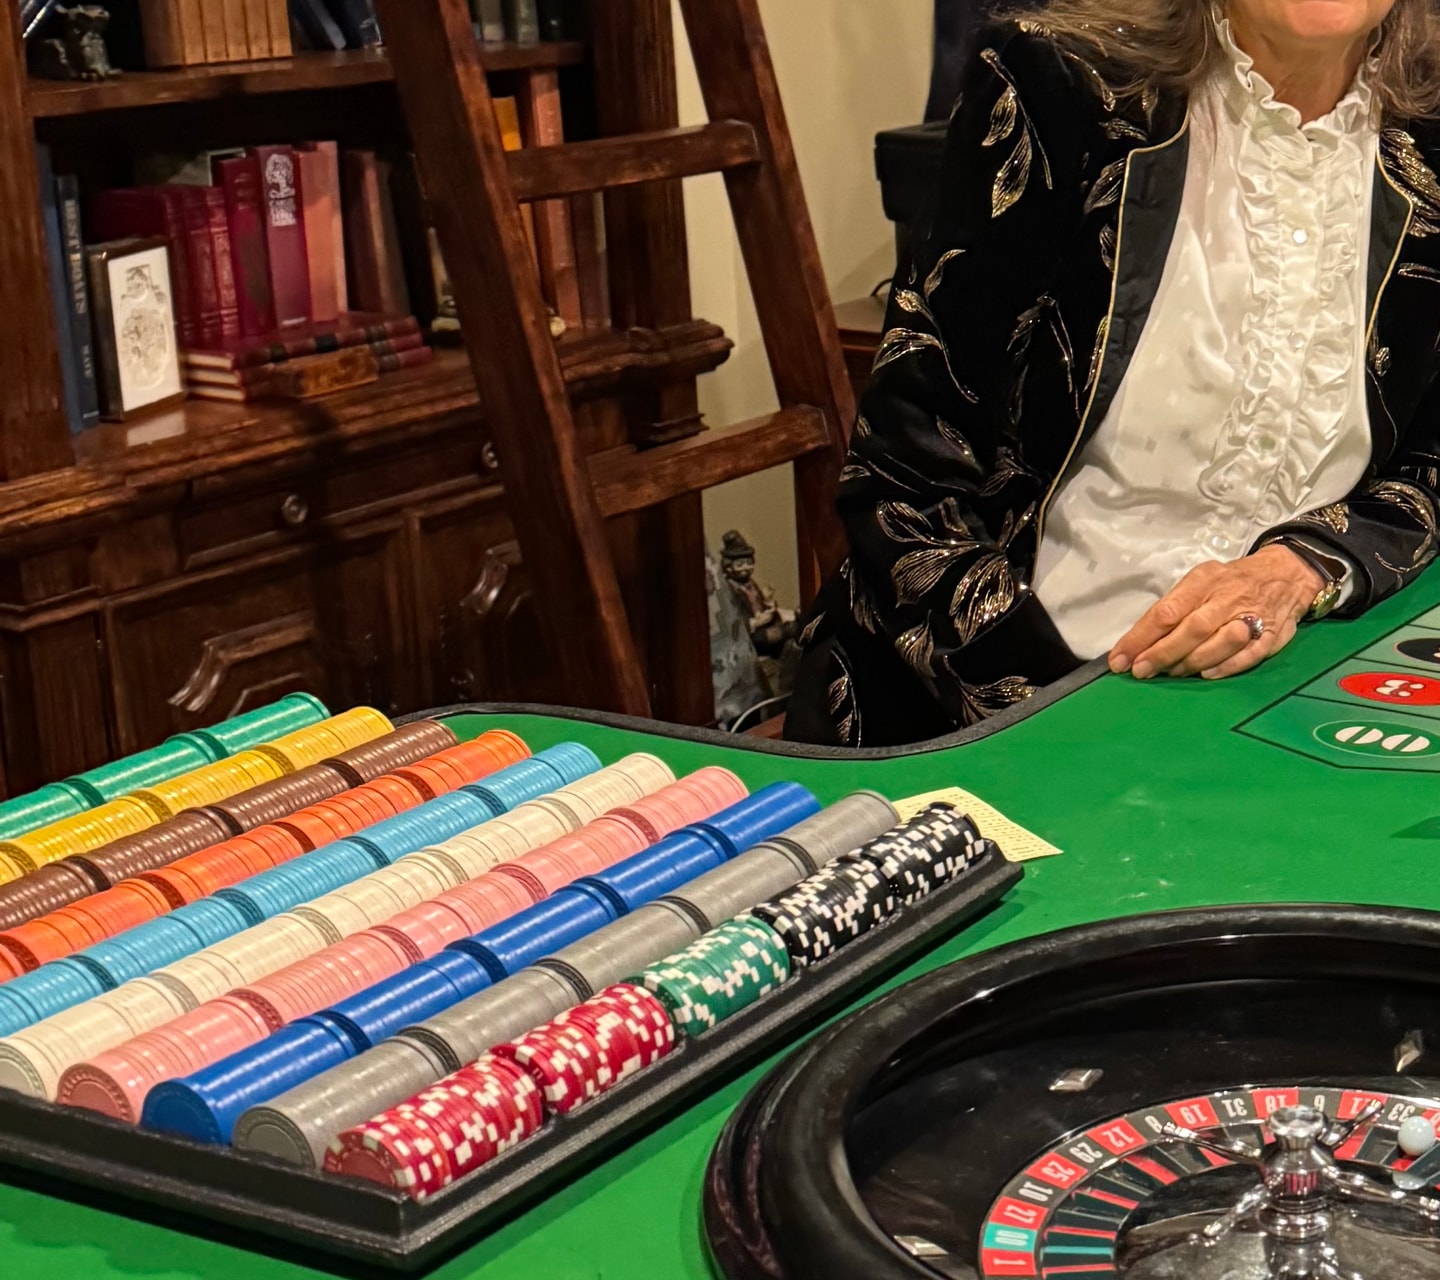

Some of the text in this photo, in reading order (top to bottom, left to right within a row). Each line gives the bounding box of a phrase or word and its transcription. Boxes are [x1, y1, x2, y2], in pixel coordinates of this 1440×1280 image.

[1376, 679, 1425, 697] 3
[1334, 726, 1431, 753] 00
[1180, 1104, 1208, 1125] 19
[1221, 1097, 1248, 1118] 31
[1102, 1126, 1134, 1148] 12
[1069, 1141, 1104, 1164] 29
[1041, 1161, 1076, 1182] 25
[1018, 1181, 1054, 1202] 10
[1003, 1204, 1038, 1224] 27
[994, 1229, 1029, 1247] 00
[993, 1257, 1027, 1266] 1
